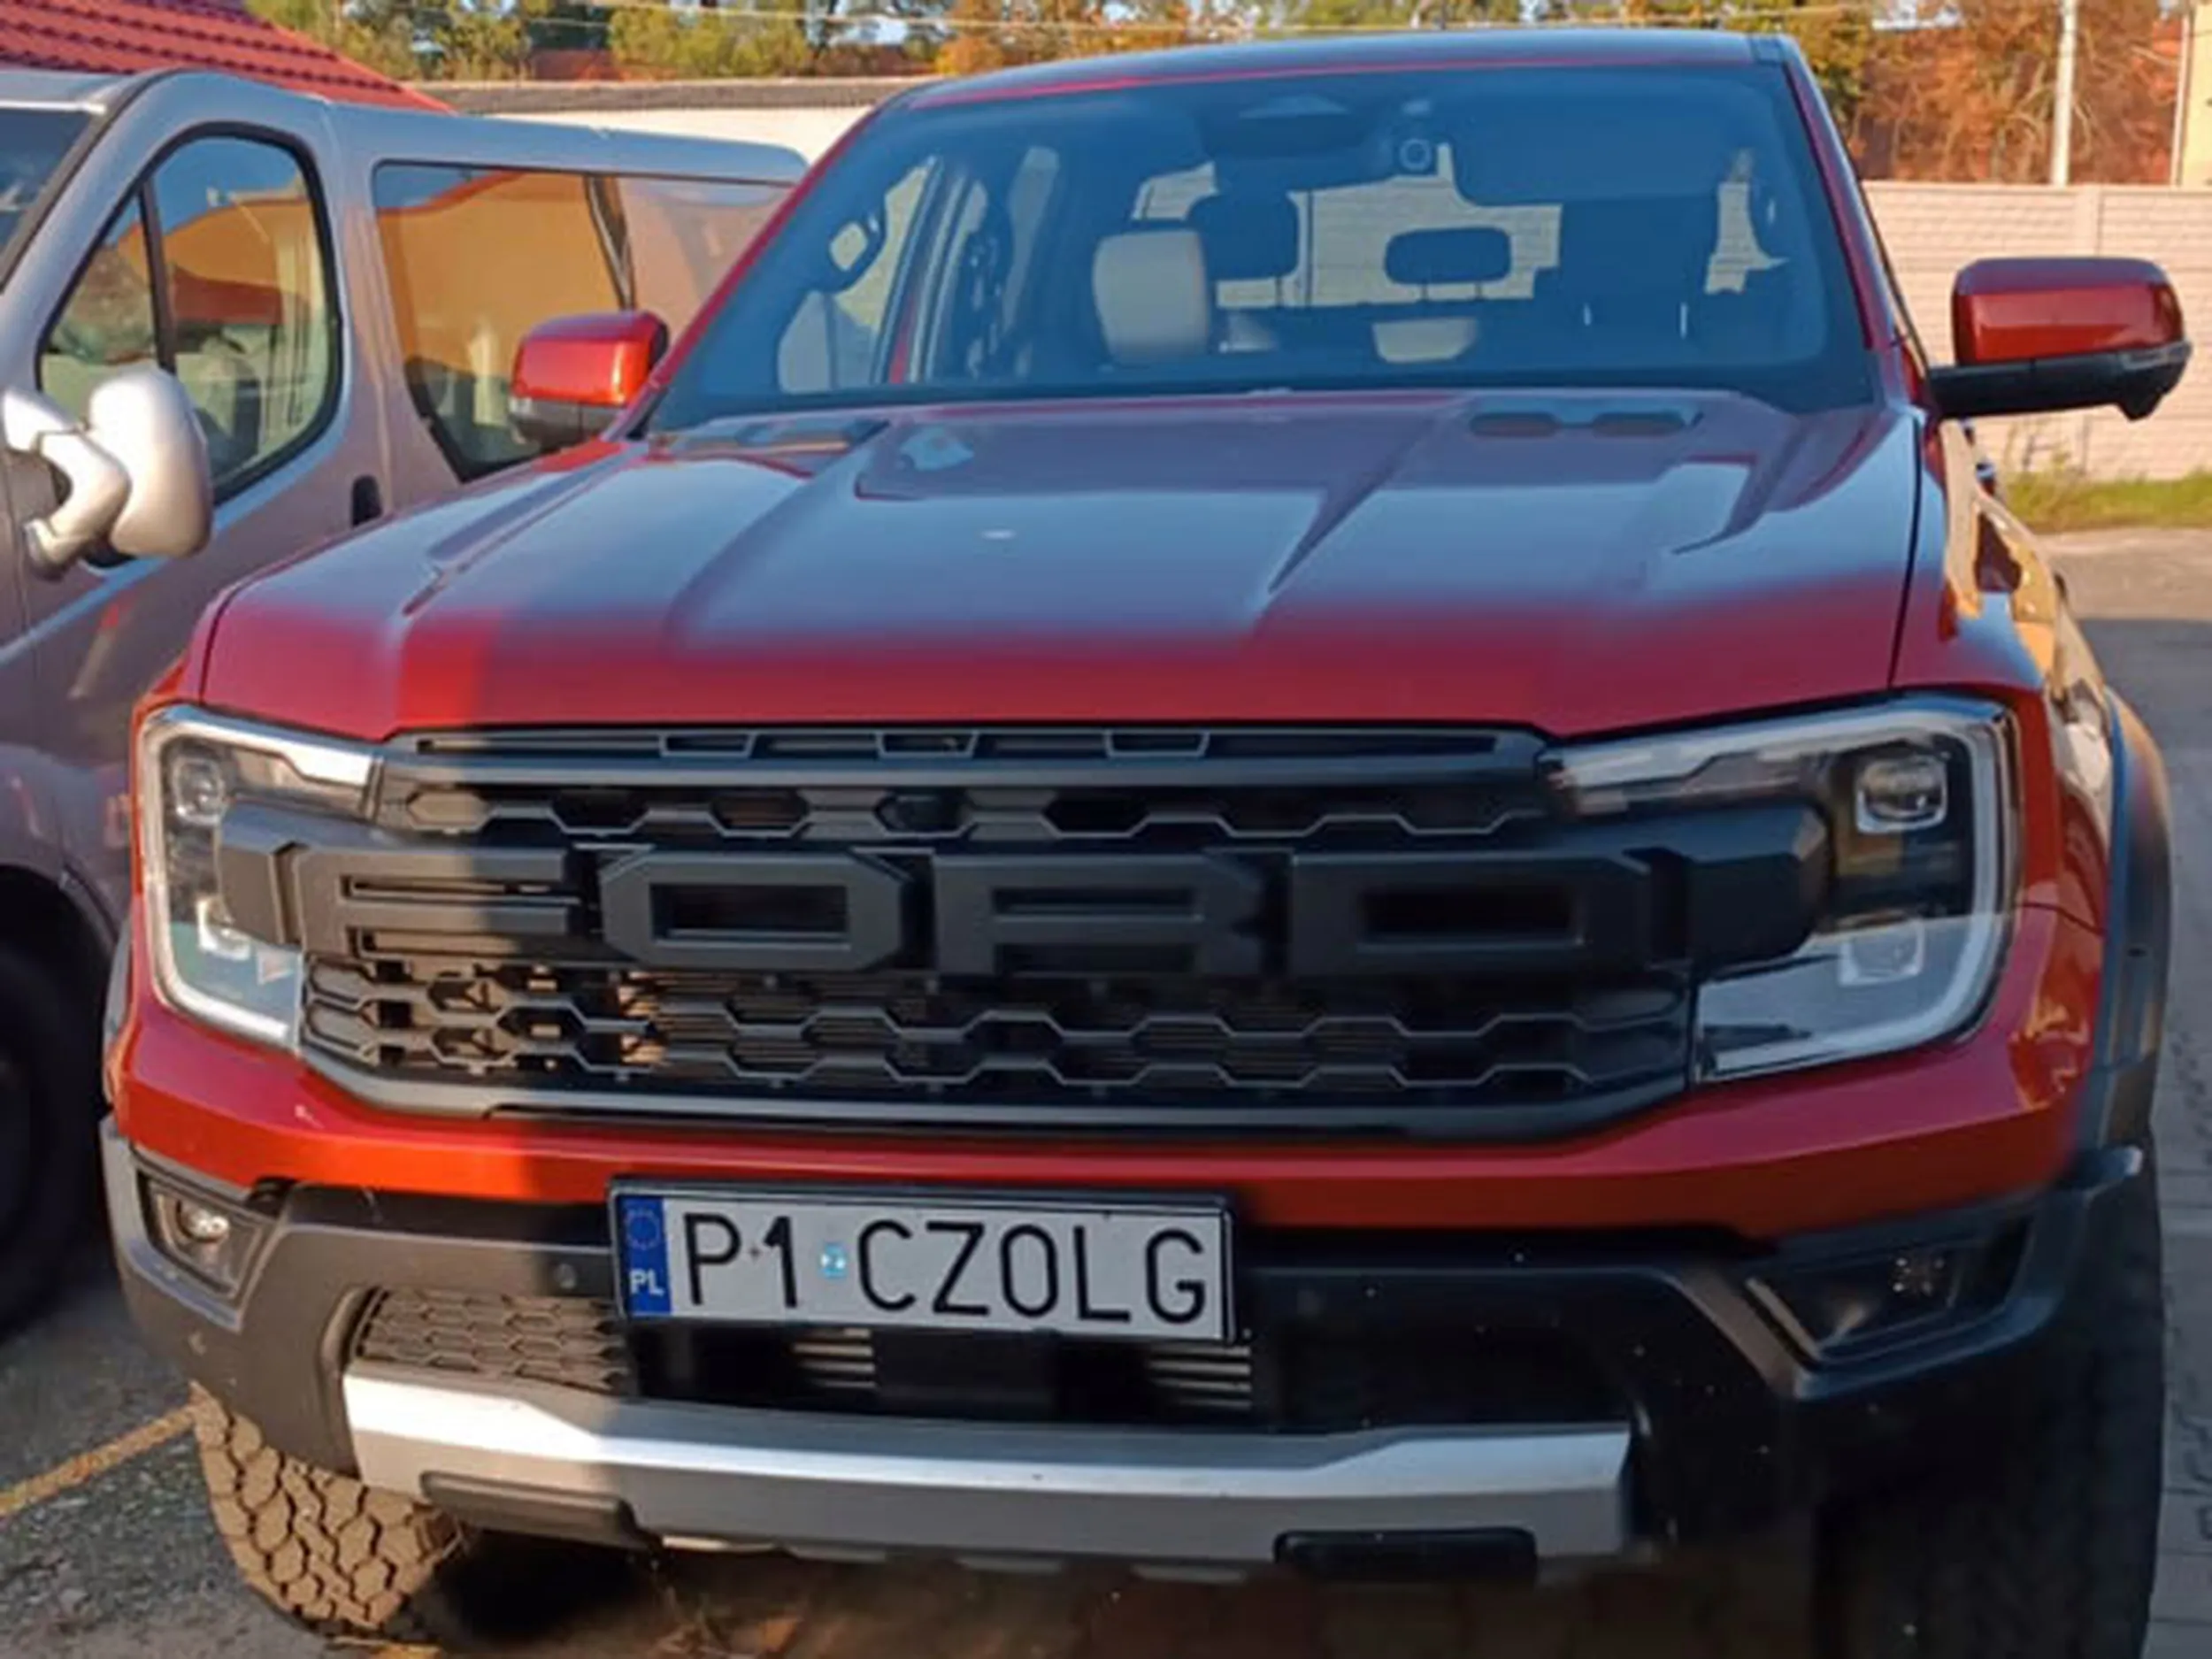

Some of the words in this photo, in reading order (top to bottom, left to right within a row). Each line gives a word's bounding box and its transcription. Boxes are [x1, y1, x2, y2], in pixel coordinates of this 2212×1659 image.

[296, 845, 1653, 980] FORD
[630, 1270, 664, 1295] PL
[683, 1212, 798, 1309] P1
